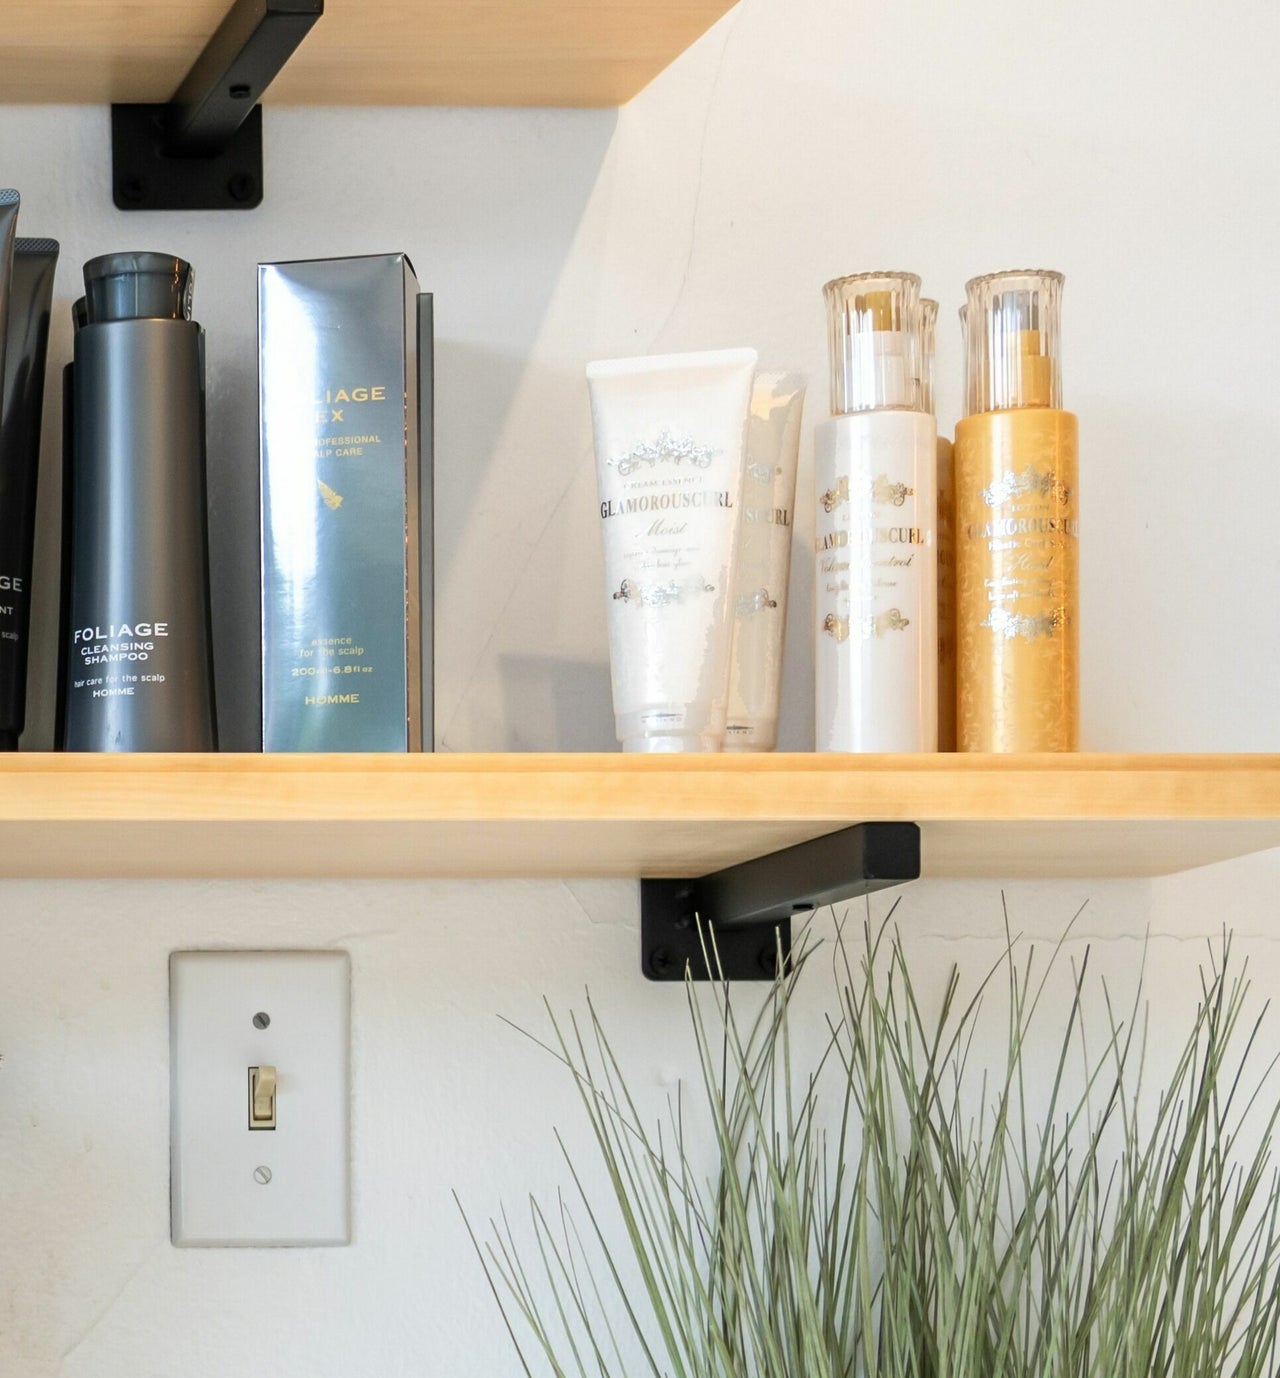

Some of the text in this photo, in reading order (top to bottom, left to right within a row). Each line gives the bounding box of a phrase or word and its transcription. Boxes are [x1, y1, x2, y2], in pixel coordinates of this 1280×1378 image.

[74, 623, 169, 644] FOLIAGE
[81, 642, 154, 656] CLEANSING
[338, 646, 364, 656] scalp
[84, 652, 149, 665] SHAMPOO
[86, 674, 166, 686] care for the scalp
[92, 688, 135, 698] HOMME
[304, 694, 360, 705] HOMME
